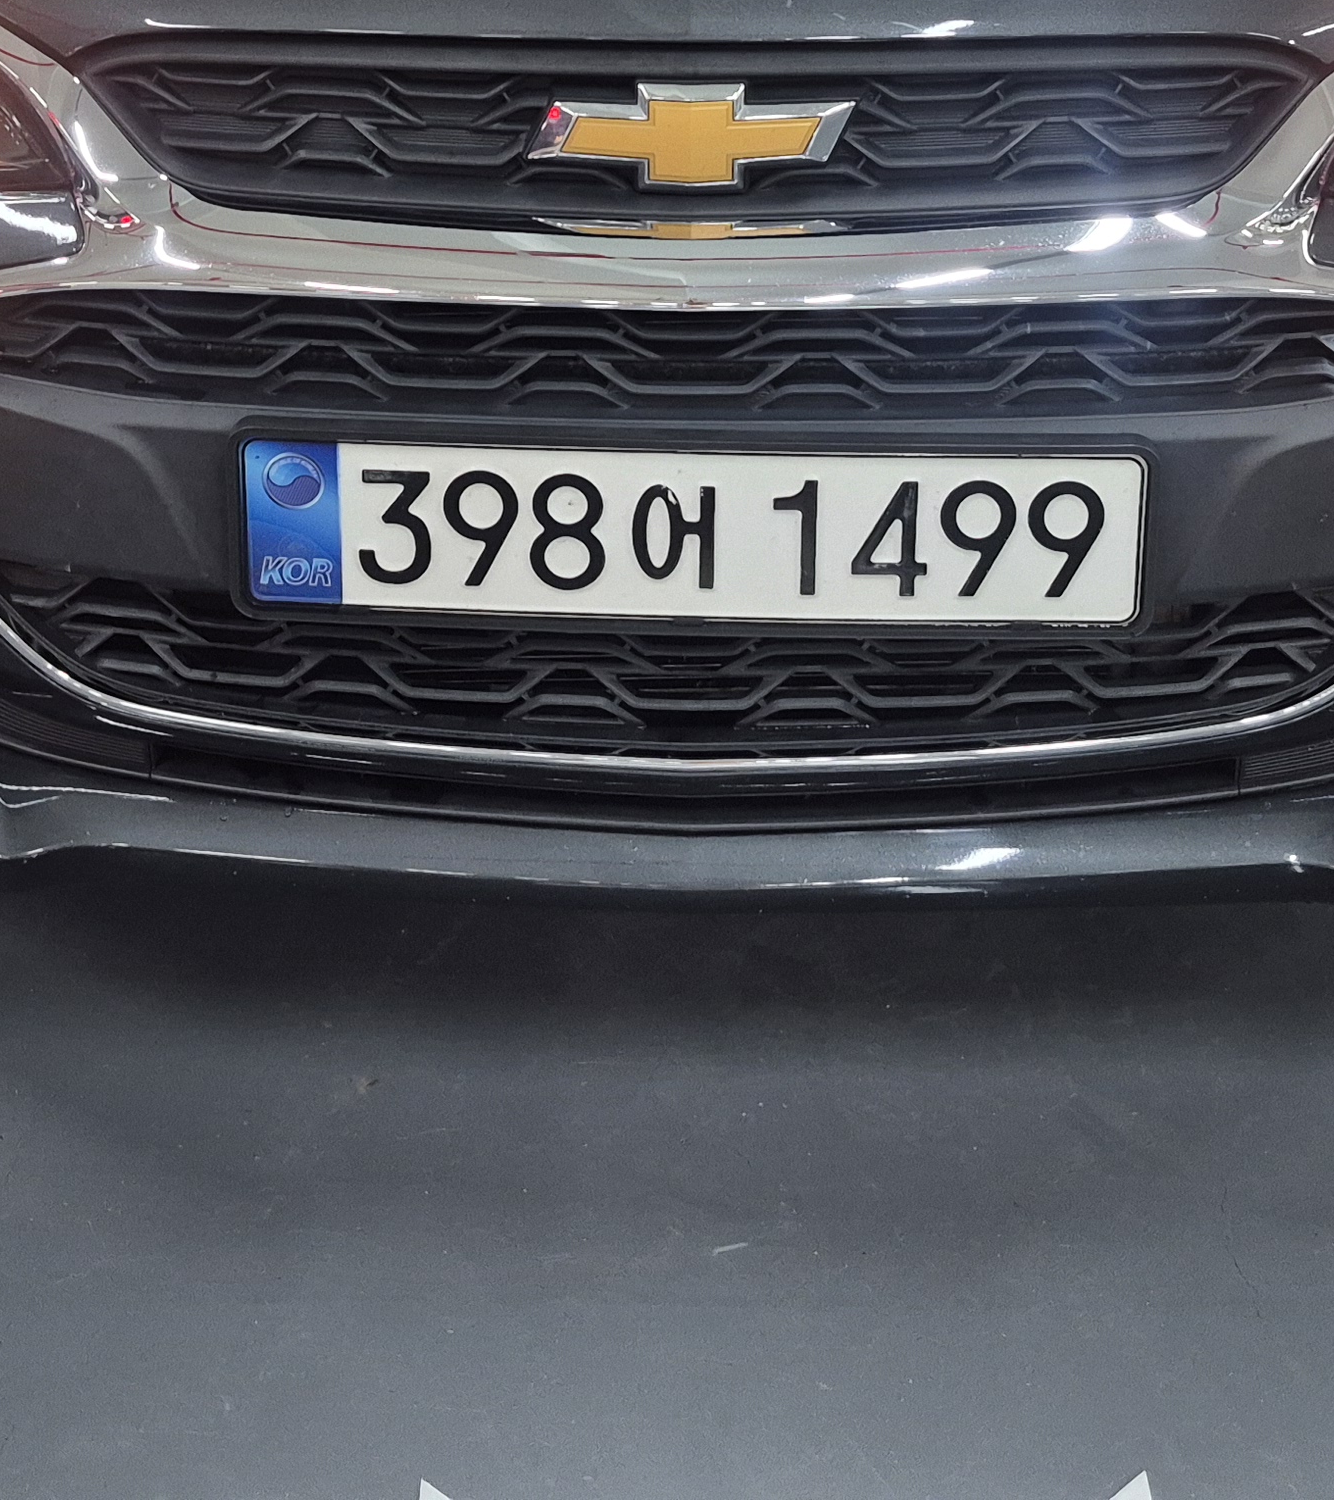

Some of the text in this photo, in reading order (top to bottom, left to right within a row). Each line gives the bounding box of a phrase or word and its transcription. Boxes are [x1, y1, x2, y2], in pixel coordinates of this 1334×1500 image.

[259, 556, 334, 587] KOR
[358, 469, 1105, 597] 398어 1499
